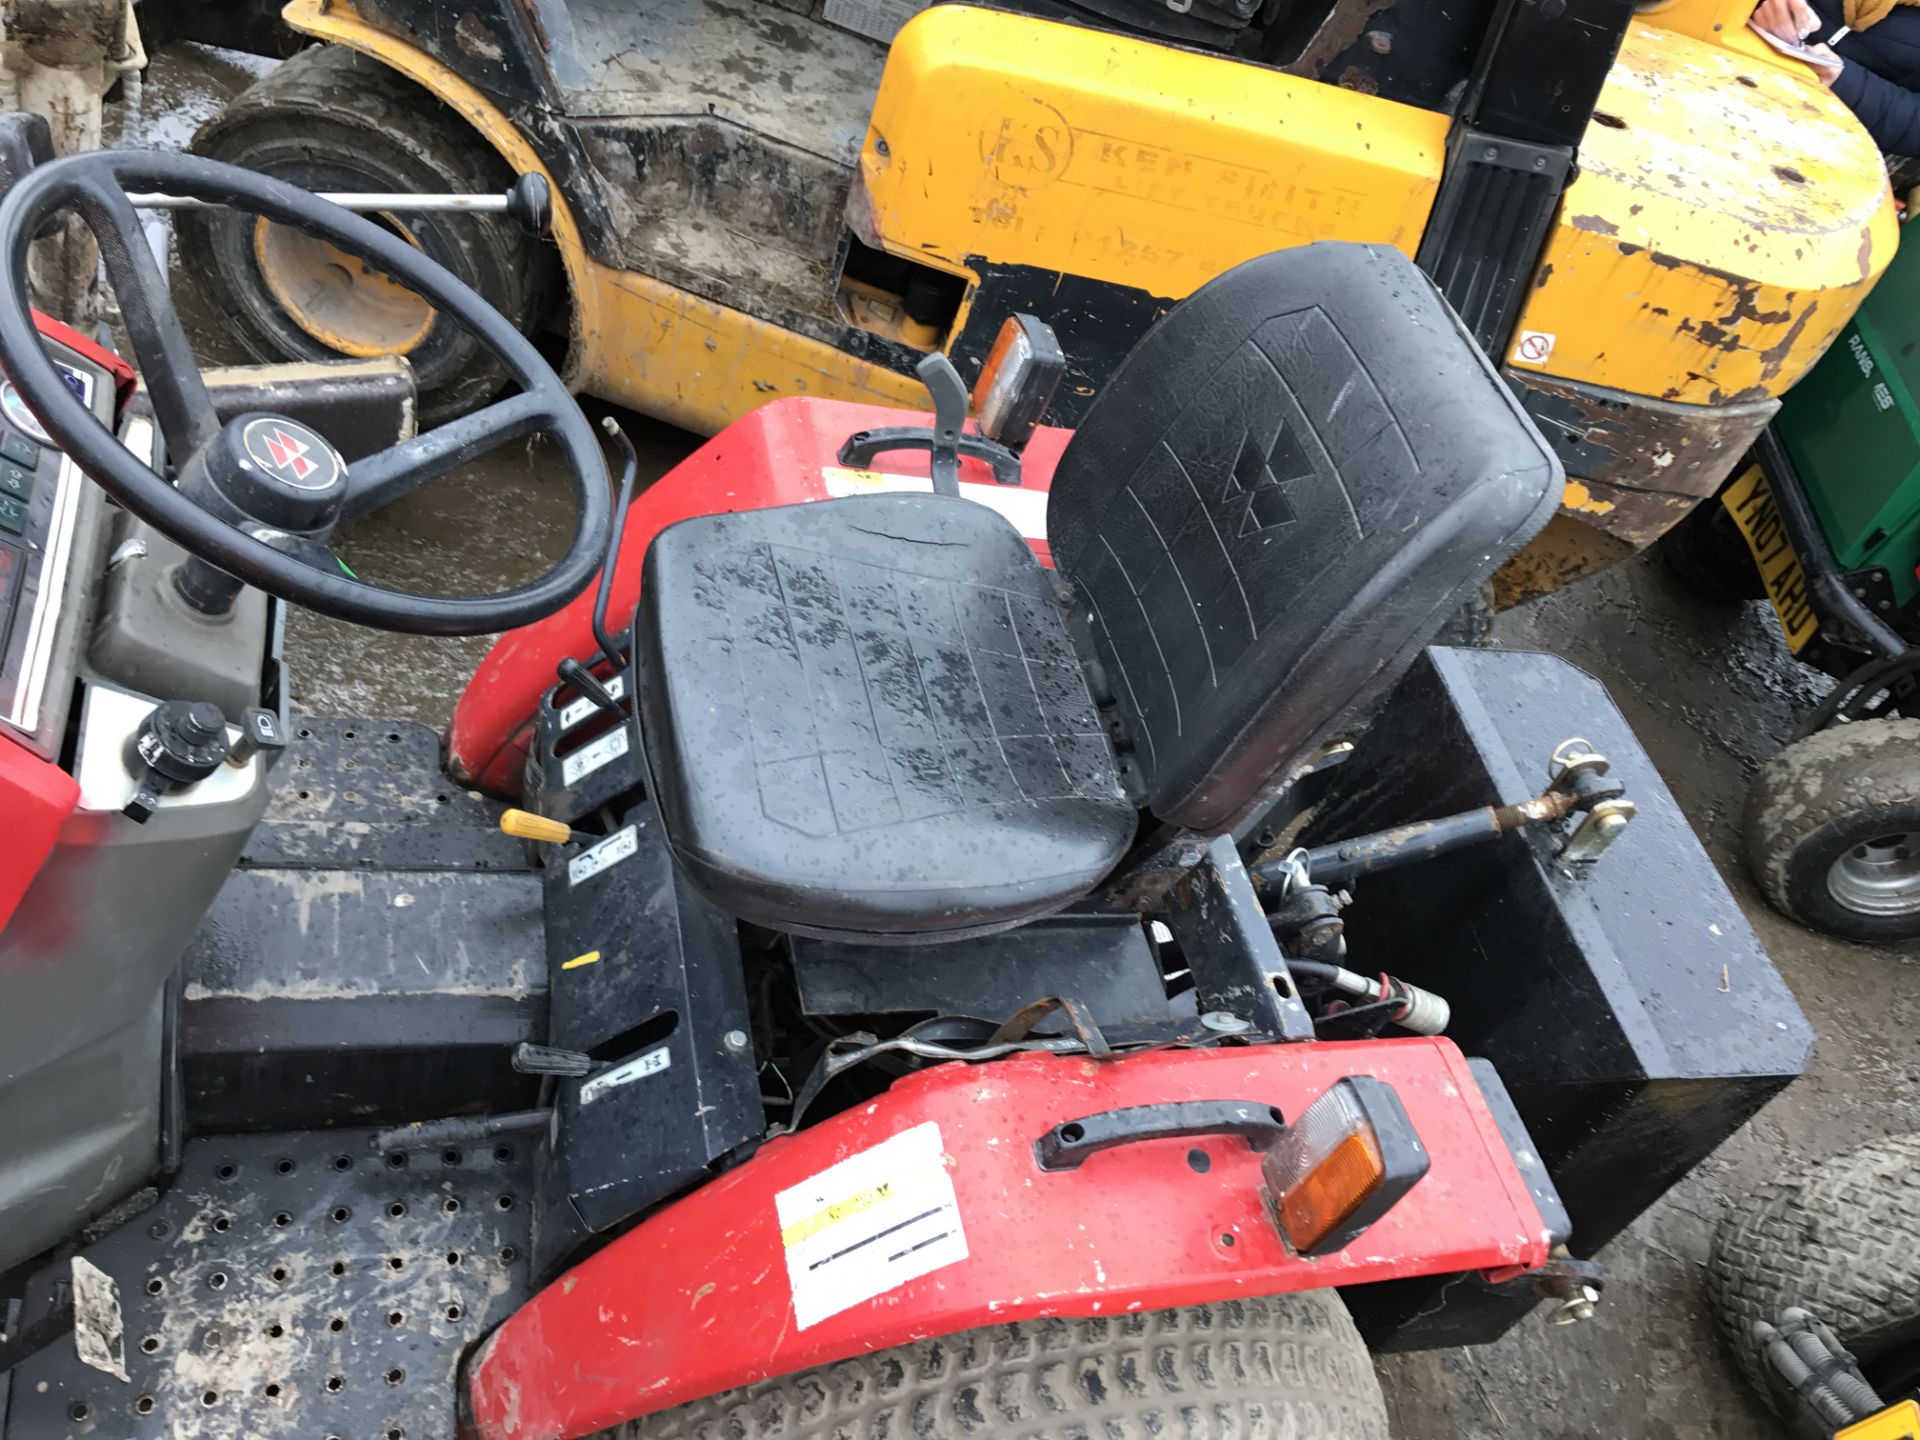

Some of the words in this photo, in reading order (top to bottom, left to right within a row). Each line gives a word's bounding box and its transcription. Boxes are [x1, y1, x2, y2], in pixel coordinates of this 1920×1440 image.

[1098, 142, 1193, 176] KEN
[1848, 334, 1895, 409] RANSES
[1736, 477, 1789, 564] YN07
